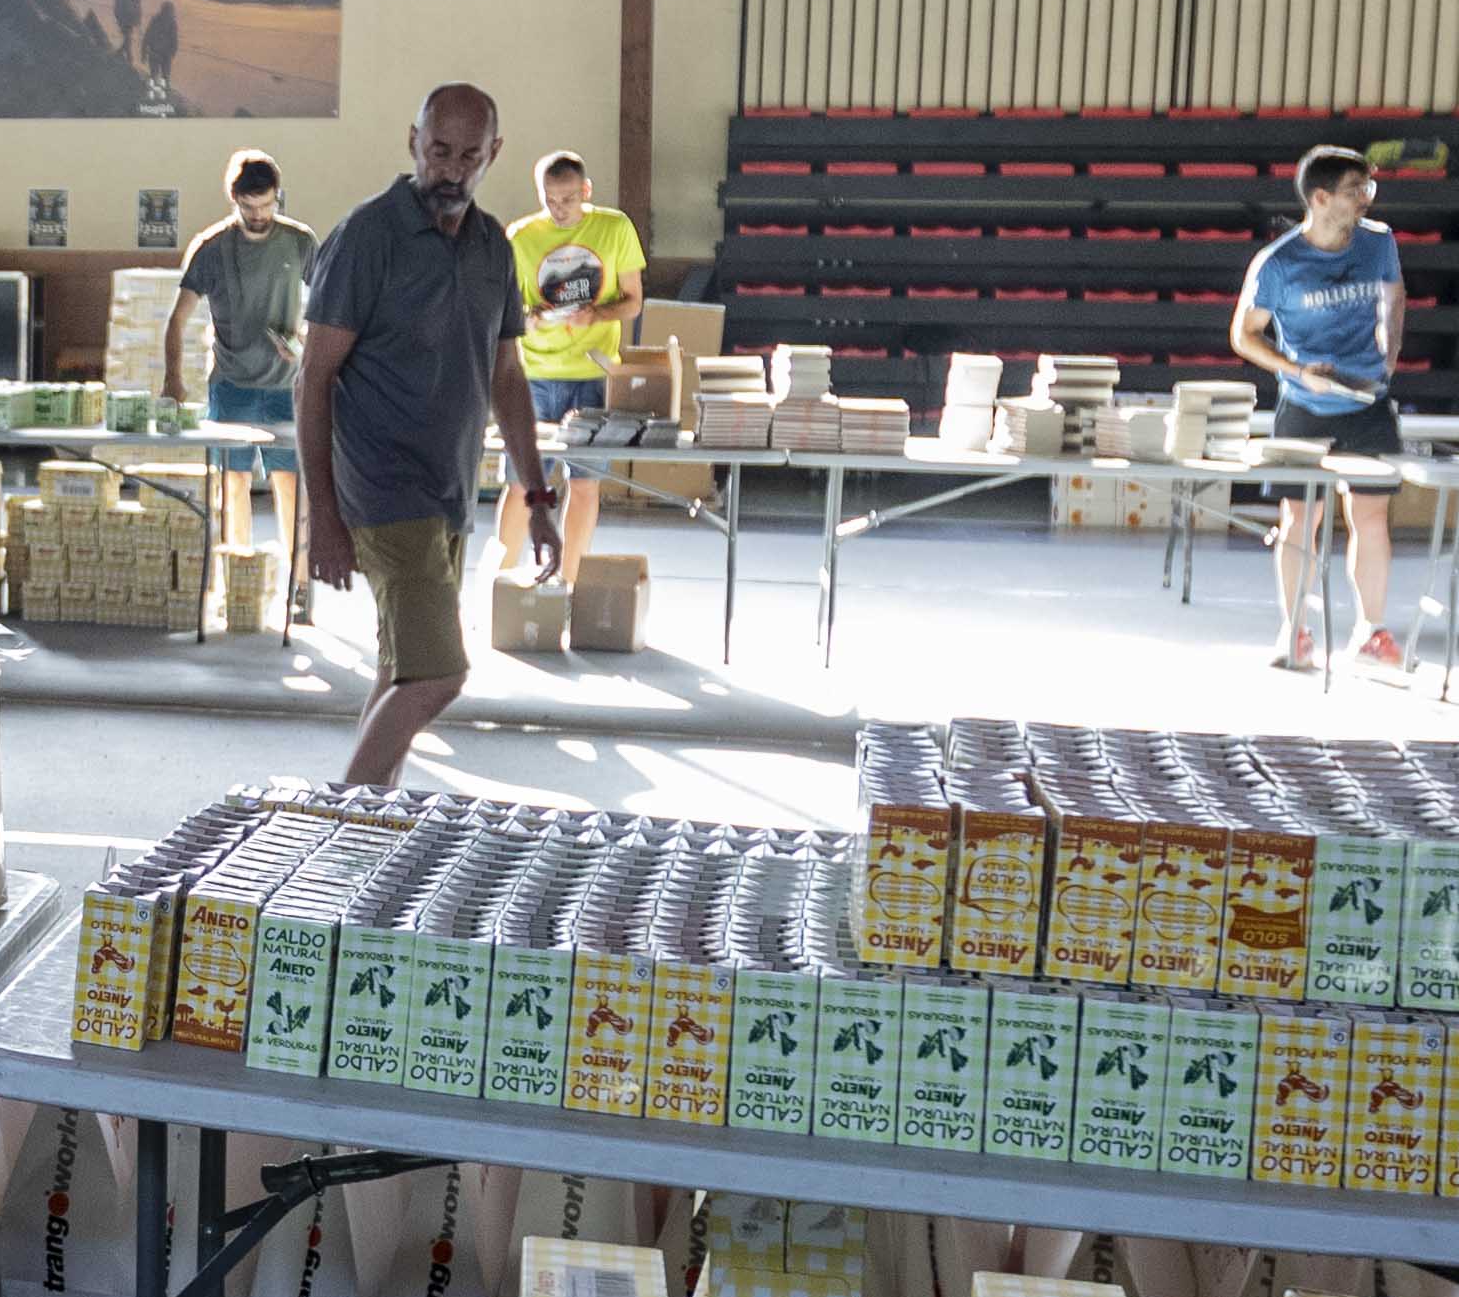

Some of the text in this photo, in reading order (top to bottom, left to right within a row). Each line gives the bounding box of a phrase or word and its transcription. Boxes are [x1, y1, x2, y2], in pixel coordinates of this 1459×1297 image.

[1302, 281, 1382, 308] HOLLISTE
[190, 906, 250, 931] ANETO
[263, 926, 327, 948] CALDO
[869, 932, 934, 956] ANETO
[262, 943, 325, 961] NATURAL
[960, 940, 1029, 965] ANETO
[1055, 947, 1122, 972] ANETO
[269, 957, 316, 977] ANETO
[1139, 952, 1206, 979] ANETO
[1227, 962, 1299, 989] ANETO
[87, 988, 133, 1009] ANETO
[76, 1017, 137, 1040] CALDO
[346, 1024, 394, 1041] ANETO
[264, 1037, 318, 1053] VERDURAS
[421, 1035, 469, 1053] ANETO
[502, 1046, 550, 1063] ANETO
[335, 1053, 399, 1074] CALDO
[582, 1053, 631, 1072] ANETO
[410, 1065, 474, 1087] CALDO
[491, 1075, 556, 1096] CALDO
[746, 1072, 797, 1090] ANETO
[831, 1081, 882, 1099] ANETO
[915, 1088, 968, 1106] ANETO
[652, 1093, 719, 1115] CALDO
[736, 1102, 804, 1123] CALDO
[1003, 1097, 1056, 1115] ANETO
[822, 1111, 890, 1132] CALDO
[1091, 1106, 1146, 1125] ANETO
[1180, 1114, 1235, 1133] ANETO
[905, 1120, 973, 1141] CALDO
[992, 1128, 1064, 1150] CALDO
[1272, 1122, 1328, 1141] ANETO
[1364, 1131, 1421, 1150] ANETO
[1080, 1139, 1153, 1159] CALDO
[1168, 1147, 1242, 1168] CALDO
[1261, 1156, 1335, 1175] CALDO
[1354, 1165, 1430, 1187] CALDO
